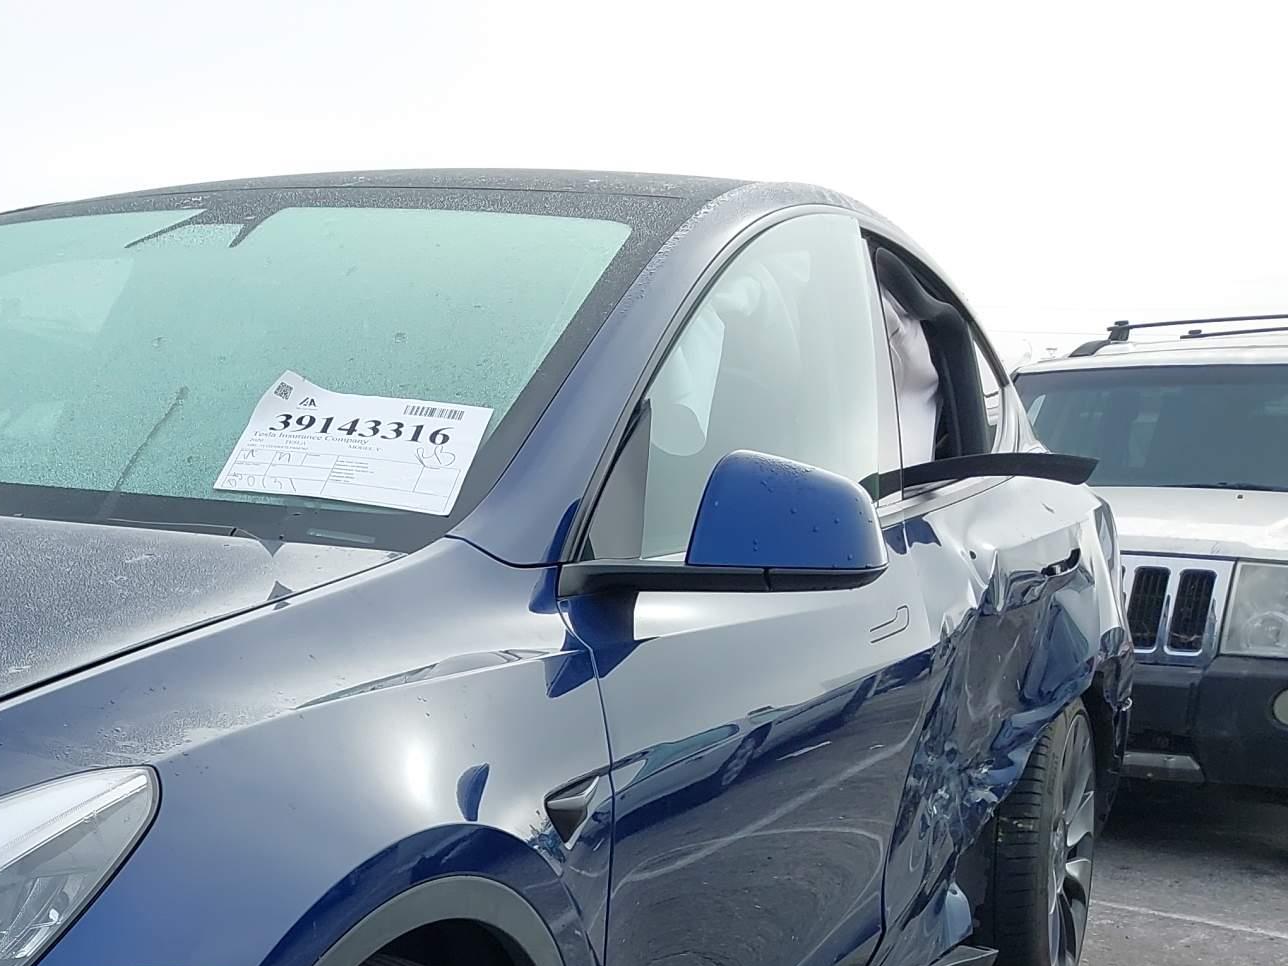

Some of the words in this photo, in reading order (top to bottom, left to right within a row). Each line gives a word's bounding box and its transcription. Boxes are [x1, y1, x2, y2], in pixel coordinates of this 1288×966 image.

[254, 431, 277, 439] Tesla
[279, 432, 323, 441] Insurance
[324, 435, 370, 445] Company
[269, 413, 454, 446] 39143316
